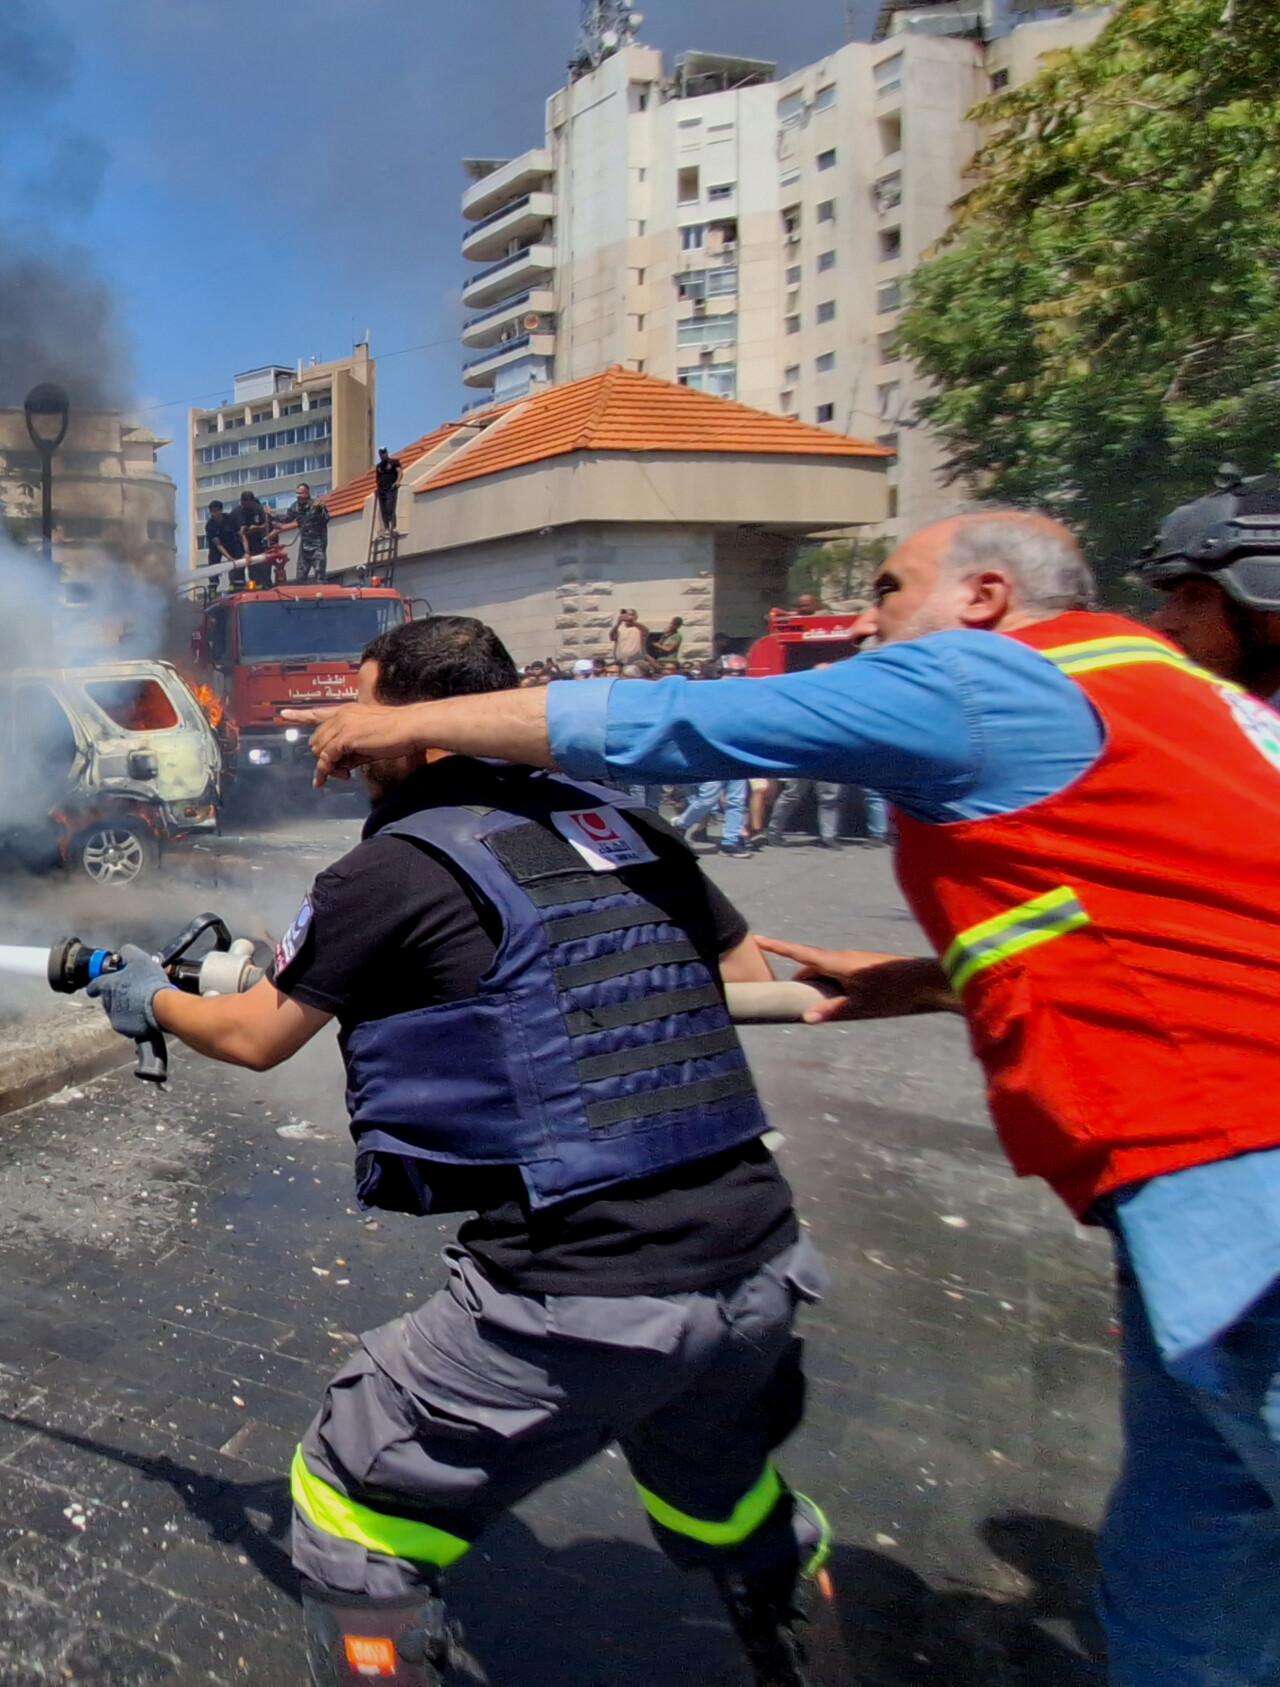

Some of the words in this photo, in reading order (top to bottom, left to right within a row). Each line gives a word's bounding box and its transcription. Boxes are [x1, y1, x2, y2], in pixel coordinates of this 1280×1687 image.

[312, 674, 346, 687] إطفاء
[288, 688, 322, 700] صيدا
[325, 686, 359, 699] بلدية
